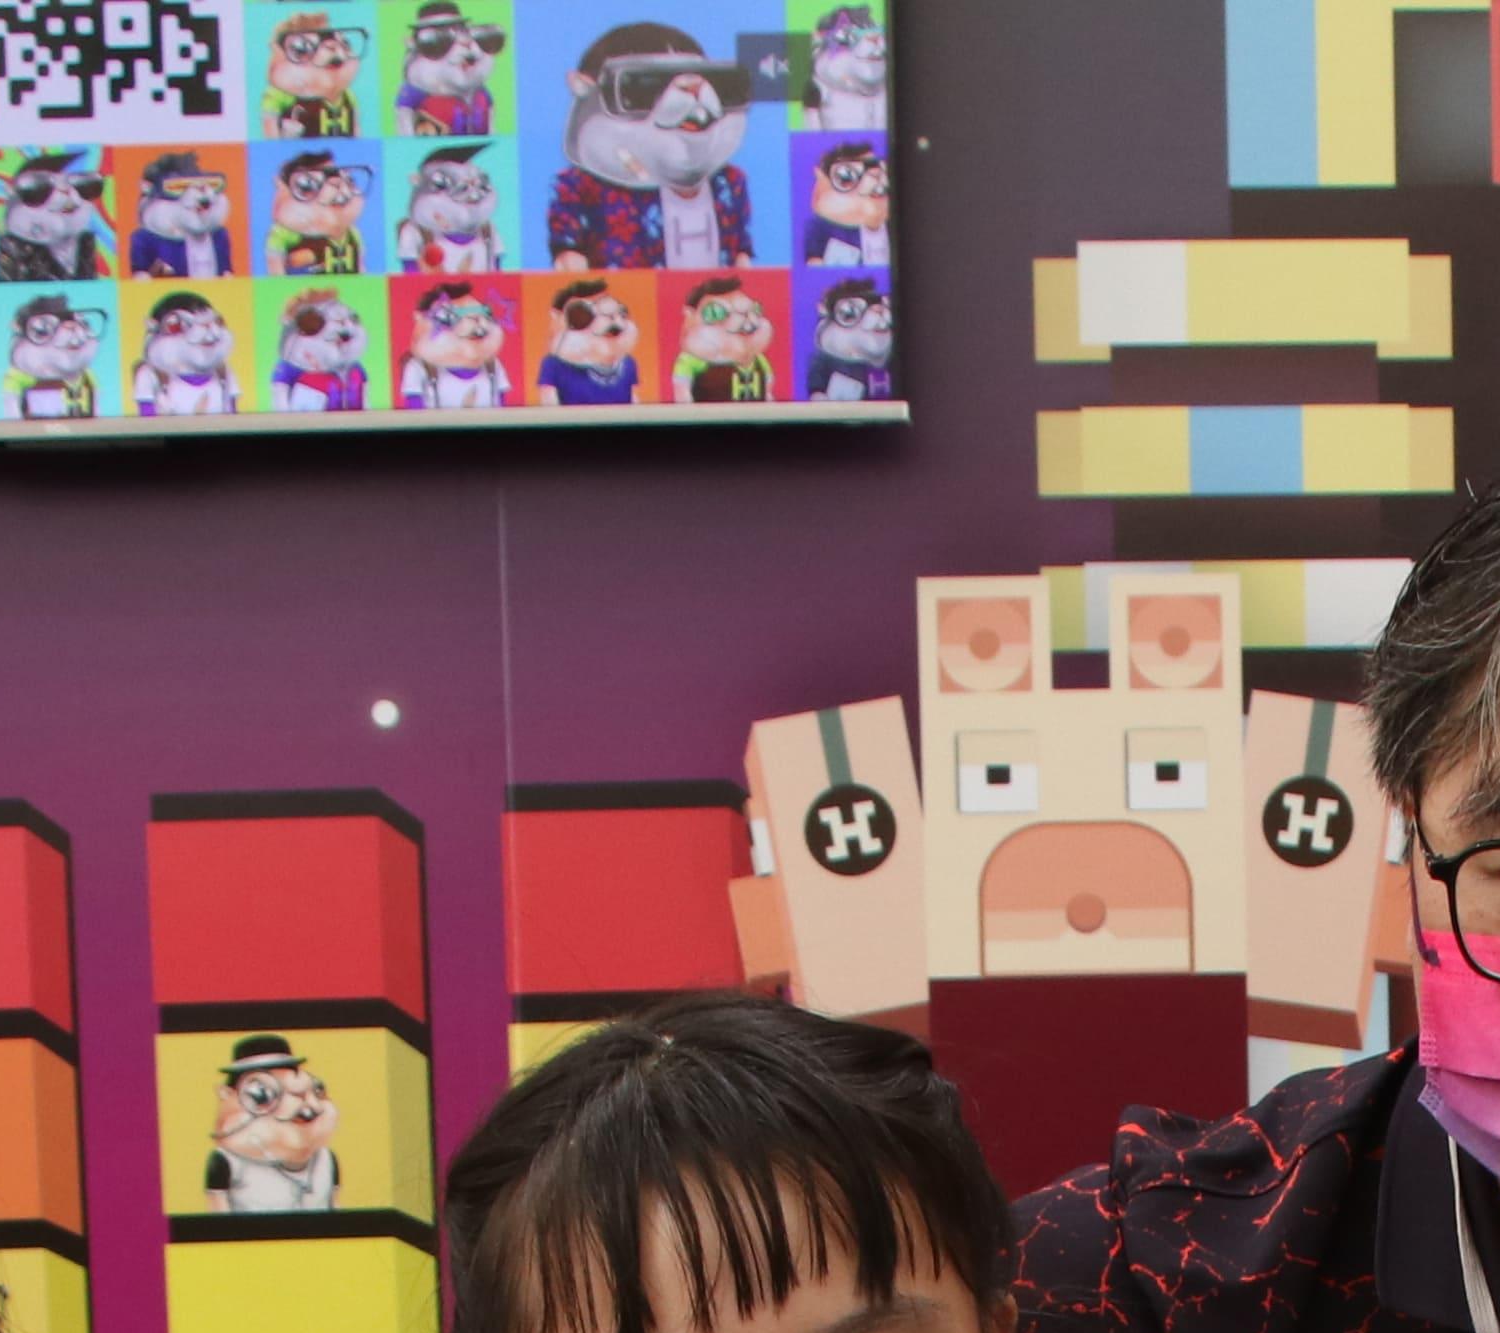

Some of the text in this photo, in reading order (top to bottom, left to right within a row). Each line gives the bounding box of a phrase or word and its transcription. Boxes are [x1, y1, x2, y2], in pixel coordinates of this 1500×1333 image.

[673, 216, 714, 256] H
[819, 800, 883, 862] H
[1276, 793, 1338, 854] H
